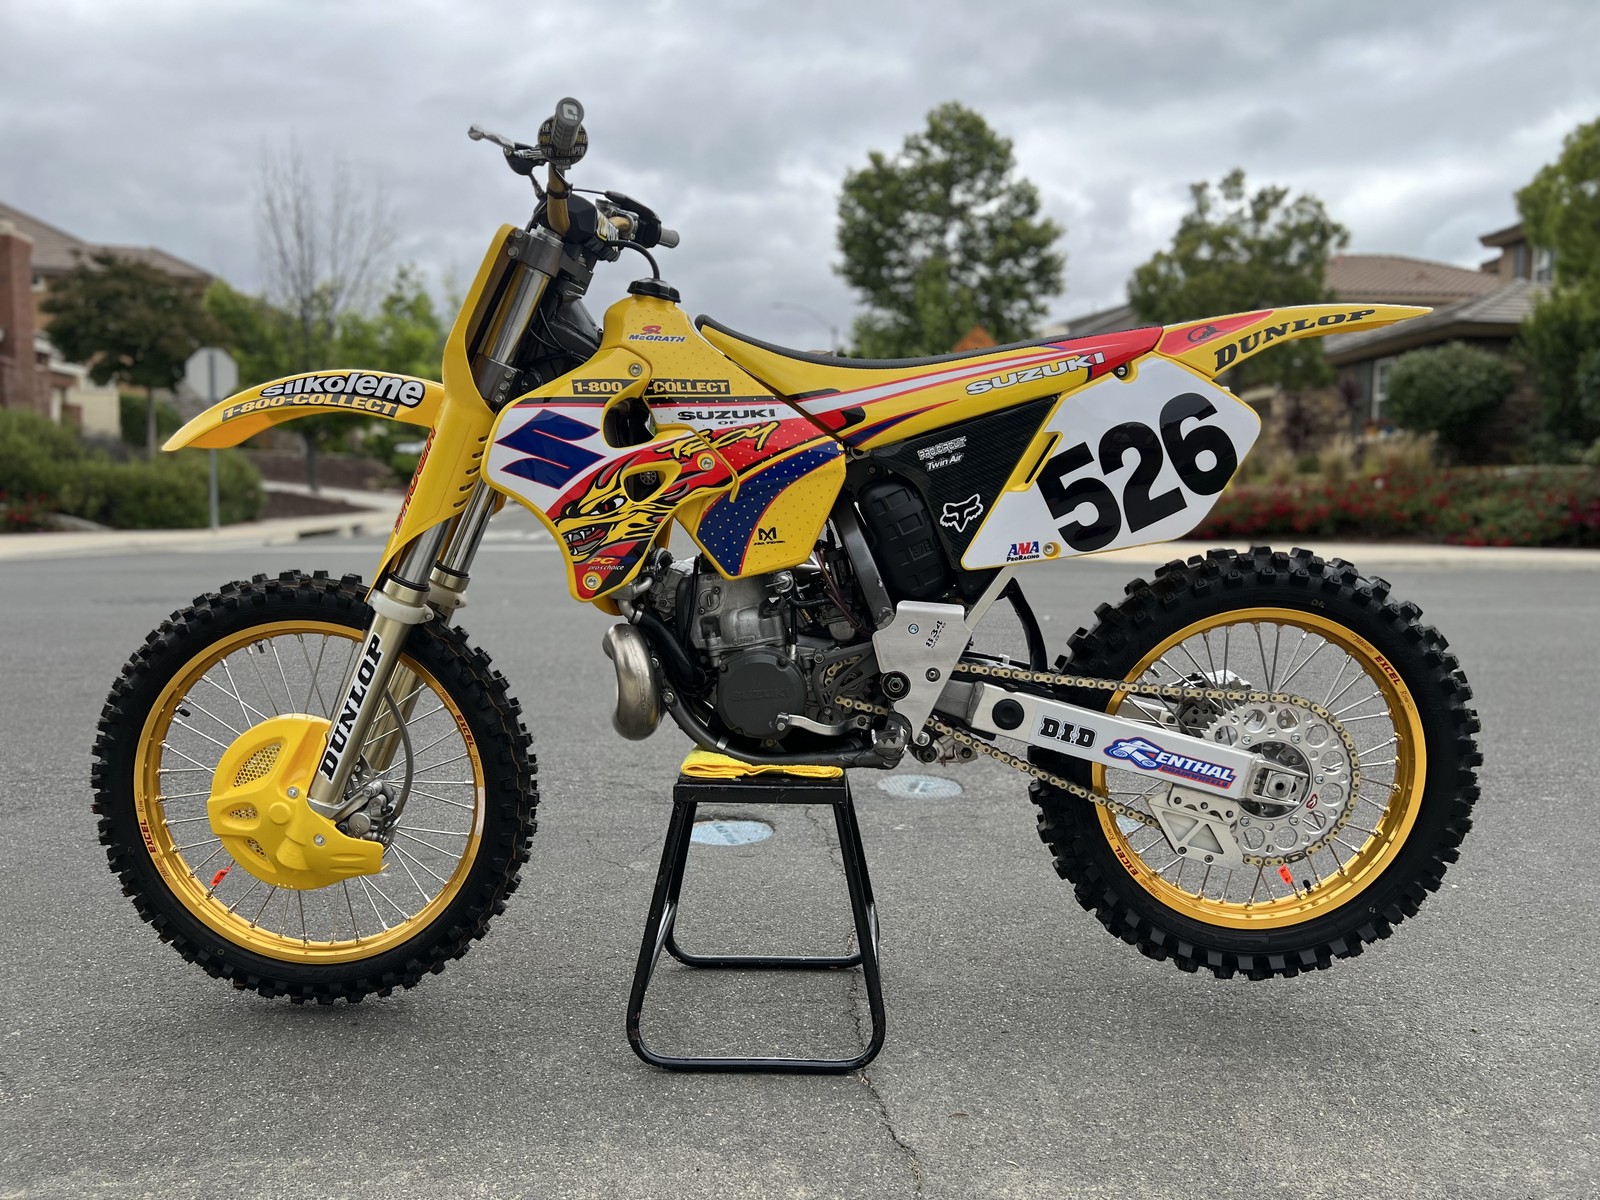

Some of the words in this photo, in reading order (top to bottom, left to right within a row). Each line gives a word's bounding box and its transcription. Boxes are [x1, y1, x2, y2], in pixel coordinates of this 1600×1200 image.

[1214, 309, 1376, 372] DUNLOP
[261, 372, 424, 406] silkolene
[966, 352, 1105, 395] SUZUKI
[224, 393, 398, 418] 1-800-COLLECT
[677, 408, 776, 421] SUZUKI
[926, 457, 950, 471] Twin
[949, 452, 963, 465] Air
[1035, 392, 1238, 553] 526
[587, 557, 616, 565] PC
[1006, 541, 1040, 556] AMA
[1374, 655, 1401, 686] EXCEL
[319, 634, 382, 782] DUNLOP
[456, 713, 475, 748] EXCEL
[1110, 738, 1234, 782] RENTHAL
[140, 818, 157, 853] EXCEL
[1114, 844, 1140, 877] EXCEL
